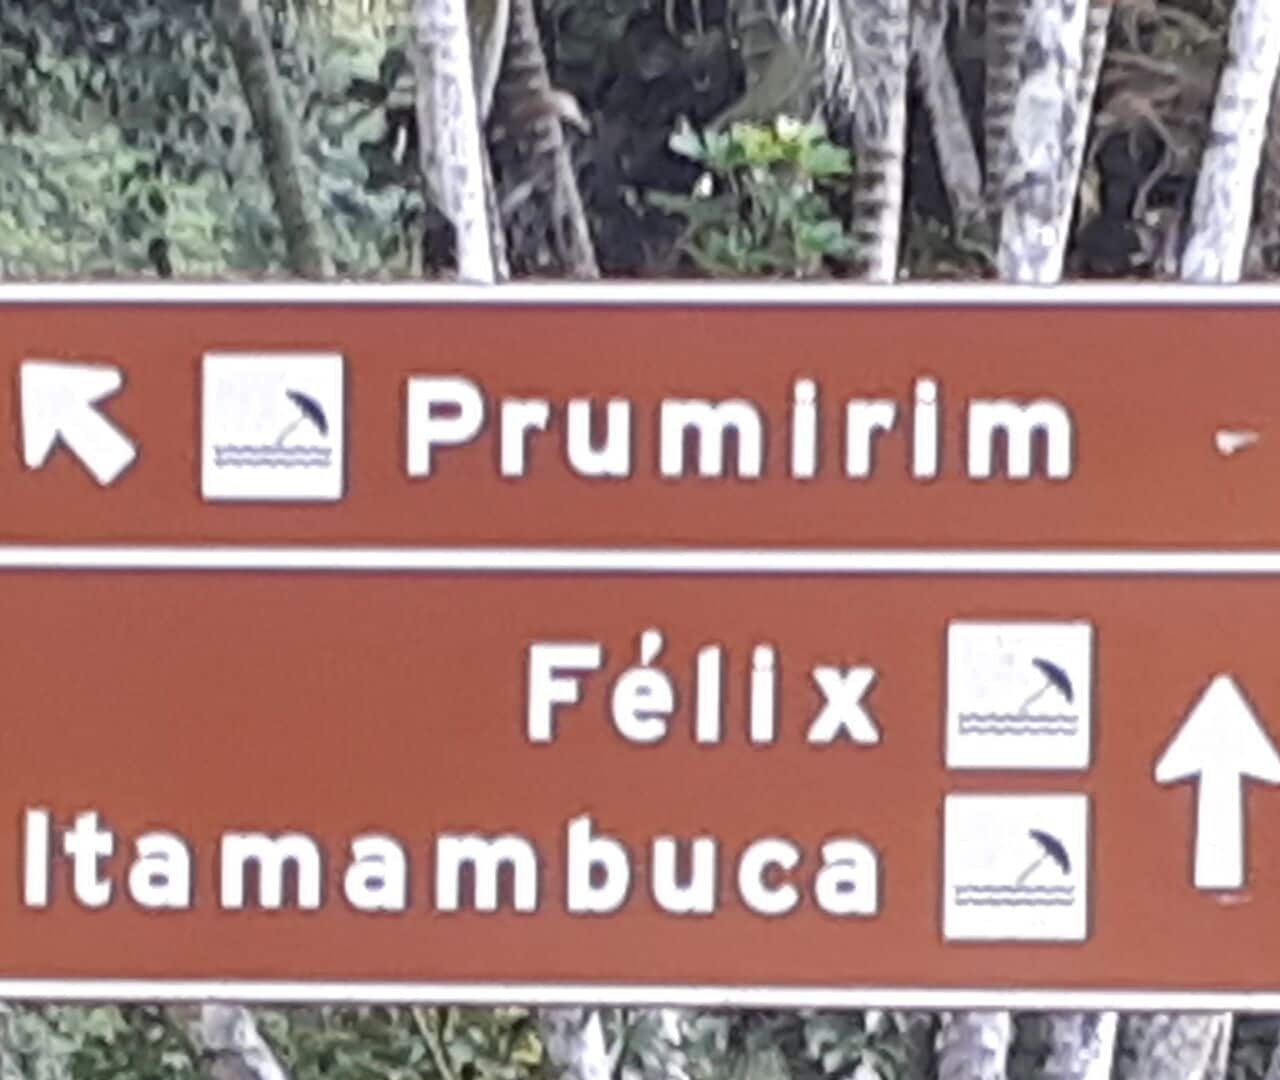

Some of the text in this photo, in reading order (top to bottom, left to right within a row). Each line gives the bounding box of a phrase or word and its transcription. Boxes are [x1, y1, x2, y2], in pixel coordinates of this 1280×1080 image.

[405, 375, 1073, 480] Prumirim
[526, 627, 881, 745] Félix
[23, 807, 879, 917] Itamambuca
